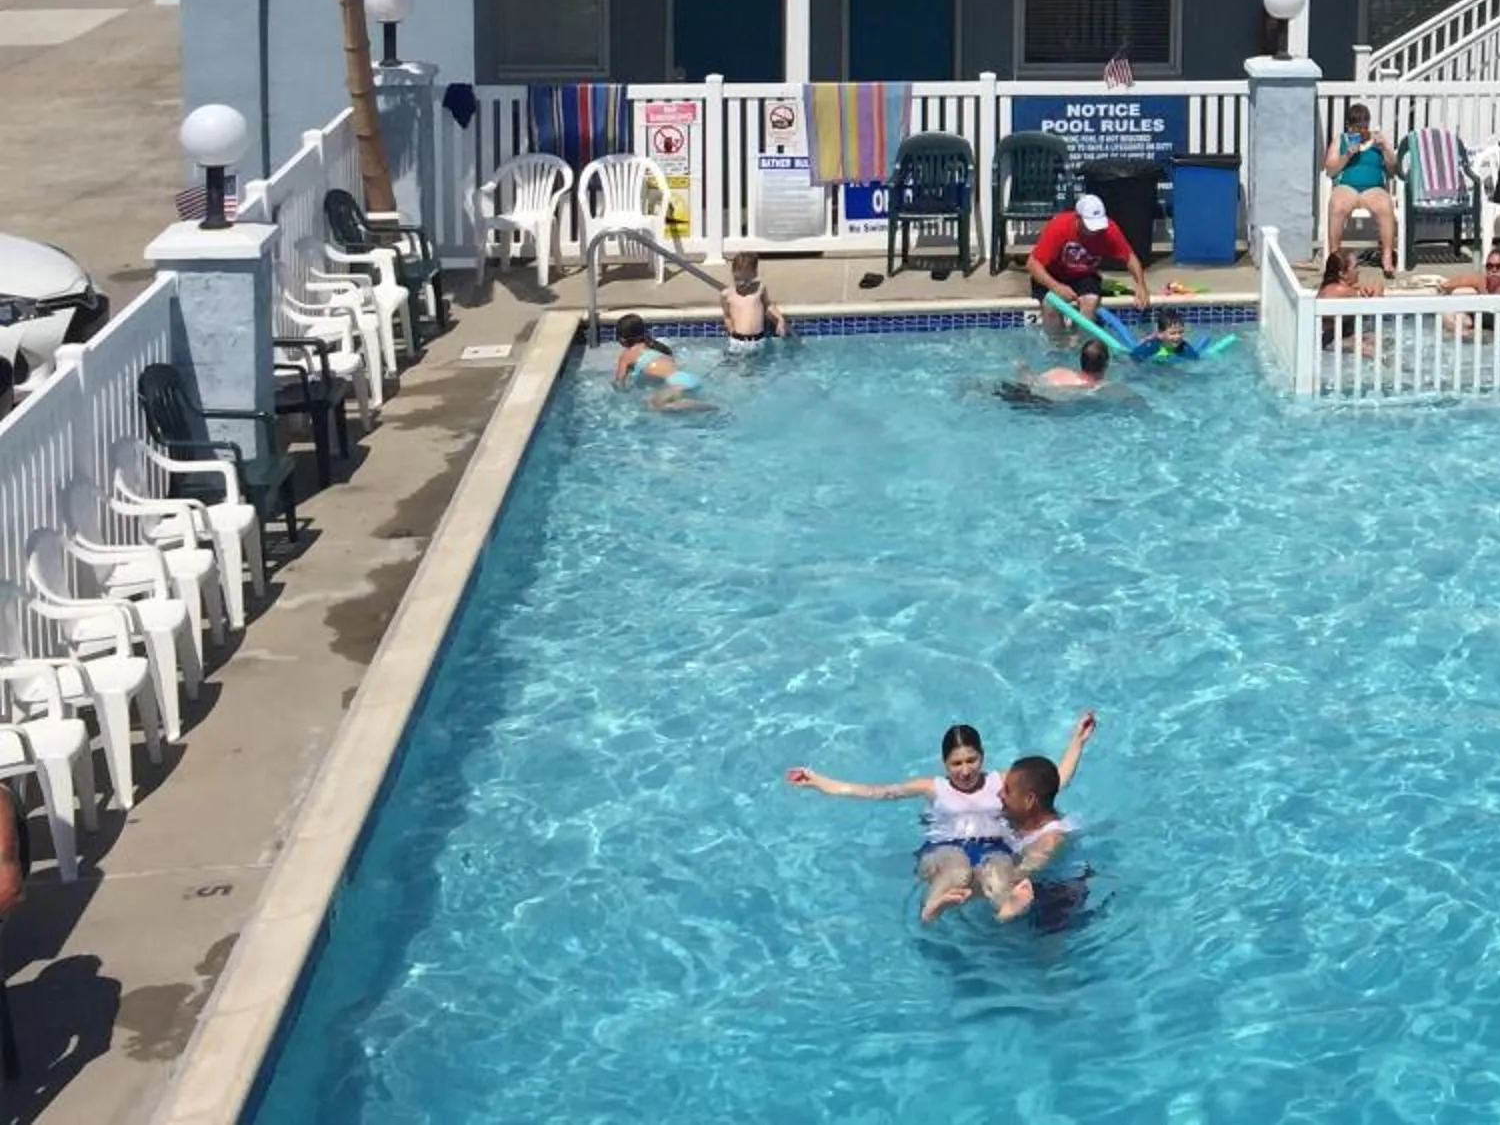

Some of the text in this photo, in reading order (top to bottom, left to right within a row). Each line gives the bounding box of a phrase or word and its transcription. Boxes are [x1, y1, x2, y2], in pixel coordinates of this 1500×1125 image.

[1066, 103, 1142, 117] NOTICE
[1041, 118, 1166, 133] POOL RULES
[196, 884, 234, 897] 5
